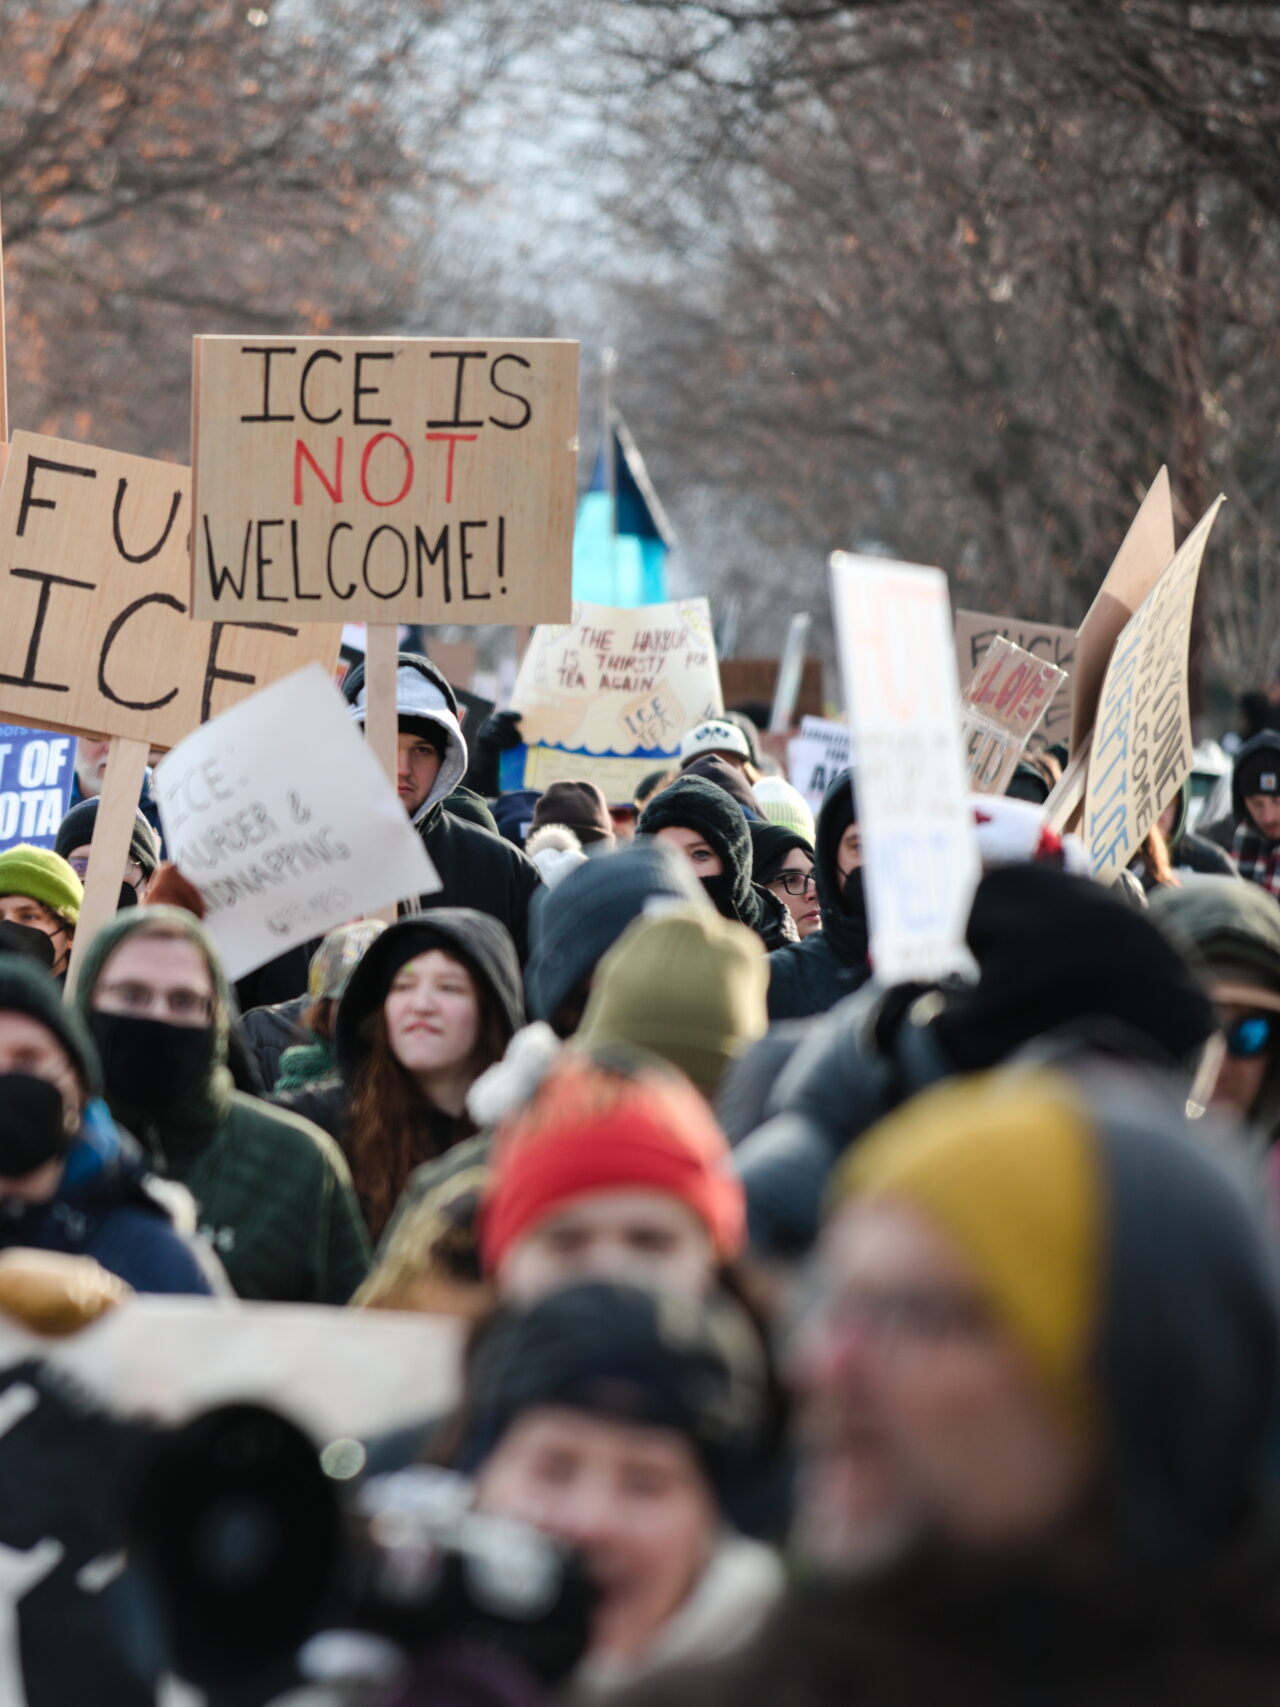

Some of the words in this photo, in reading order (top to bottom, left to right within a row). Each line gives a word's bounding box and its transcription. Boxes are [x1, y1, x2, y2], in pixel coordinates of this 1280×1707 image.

[240, 346, 400, 425] ICE
[426, 352, 531, 430] IS
[293, 432, 477, 506] NOT
[16, 454, 191, 563] FU
[202, 514, 507, 603] WELCOME!
[562, 648, 580, 667] IS
[596, 653, 666, 674] THIRSTY
[580, 626, 616, 651] THE
[557, 667, 586, 689] TEA
[599, 675, 656, 692] AGAIN
[624, 696, 665, 735] ICE
[1132, 629, 1158, 838] WELCOME
[18, 738, 70, 789] OF
